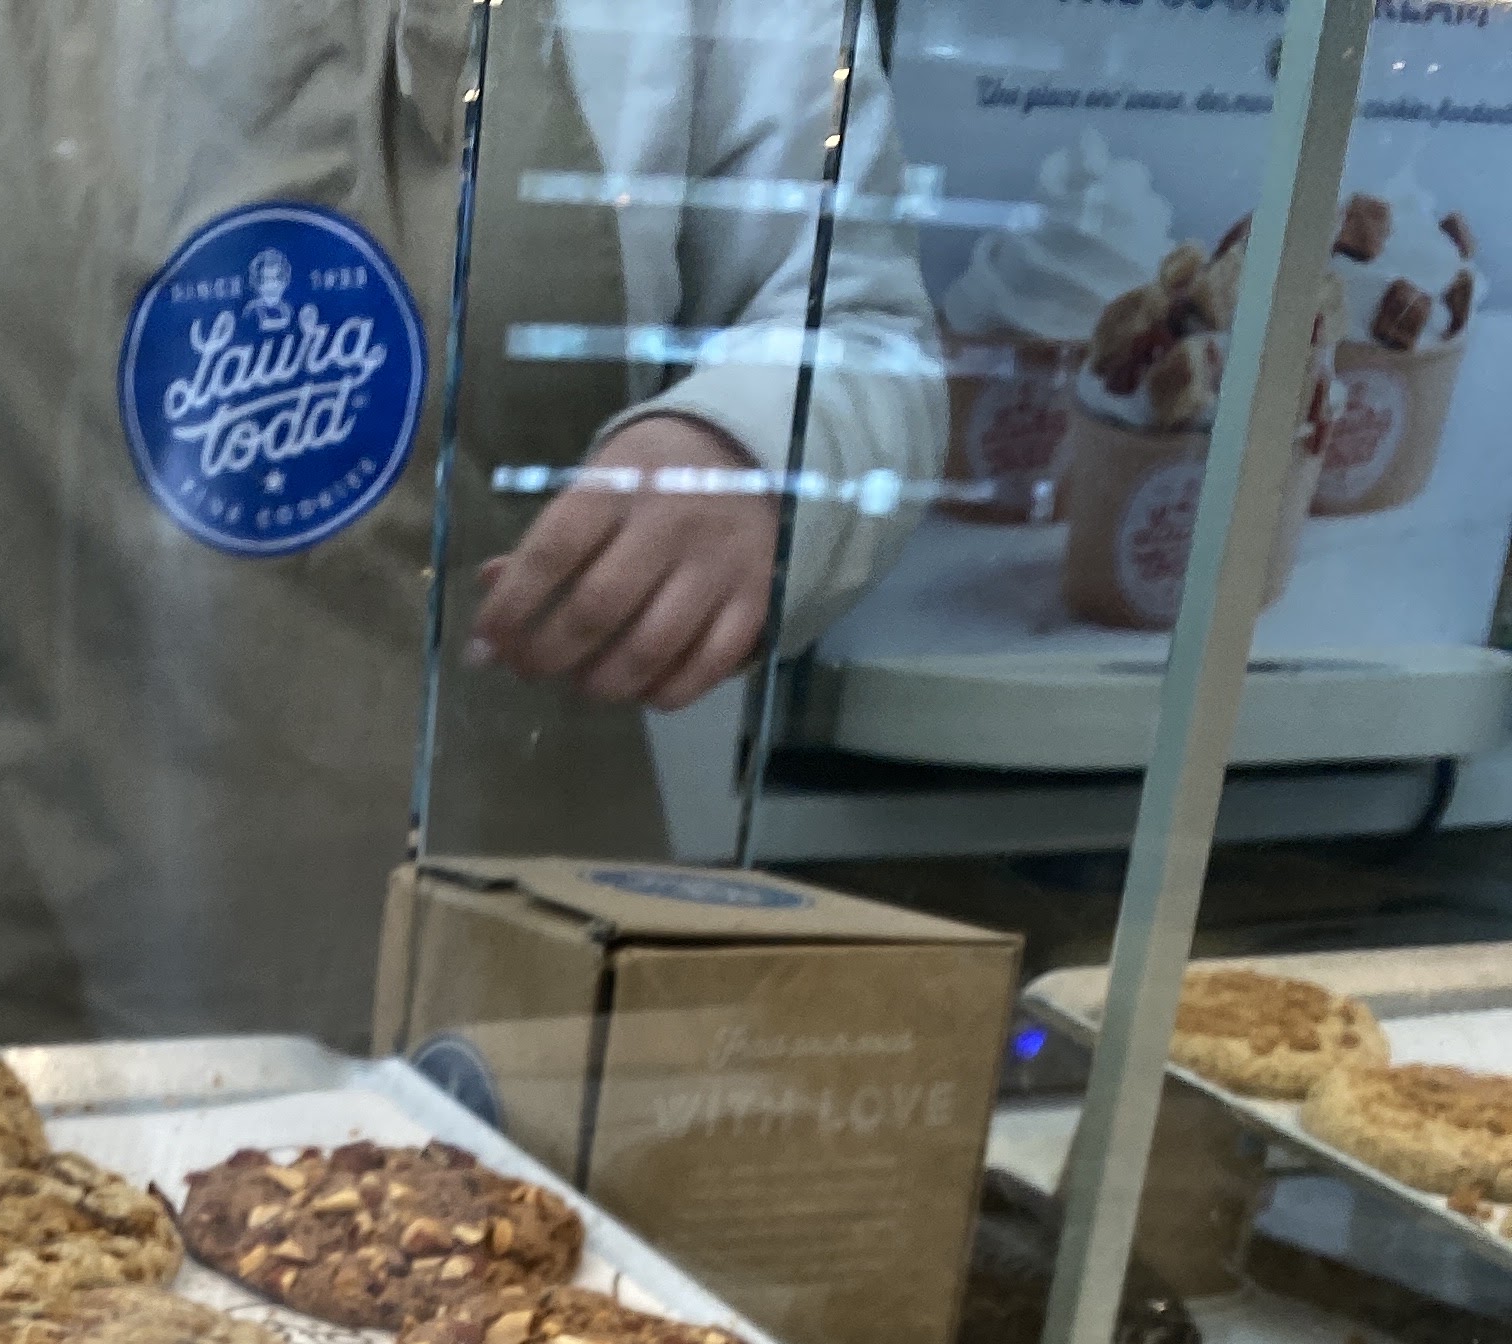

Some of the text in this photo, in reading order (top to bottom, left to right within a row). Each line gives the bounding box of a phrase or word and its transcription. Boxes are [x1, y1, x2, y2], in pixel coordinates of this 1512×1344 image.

[163, 303, 387, 422] Laura
[172, 376, 357, 477] Todd
[817, 1080, 957, 1138] LOVE
